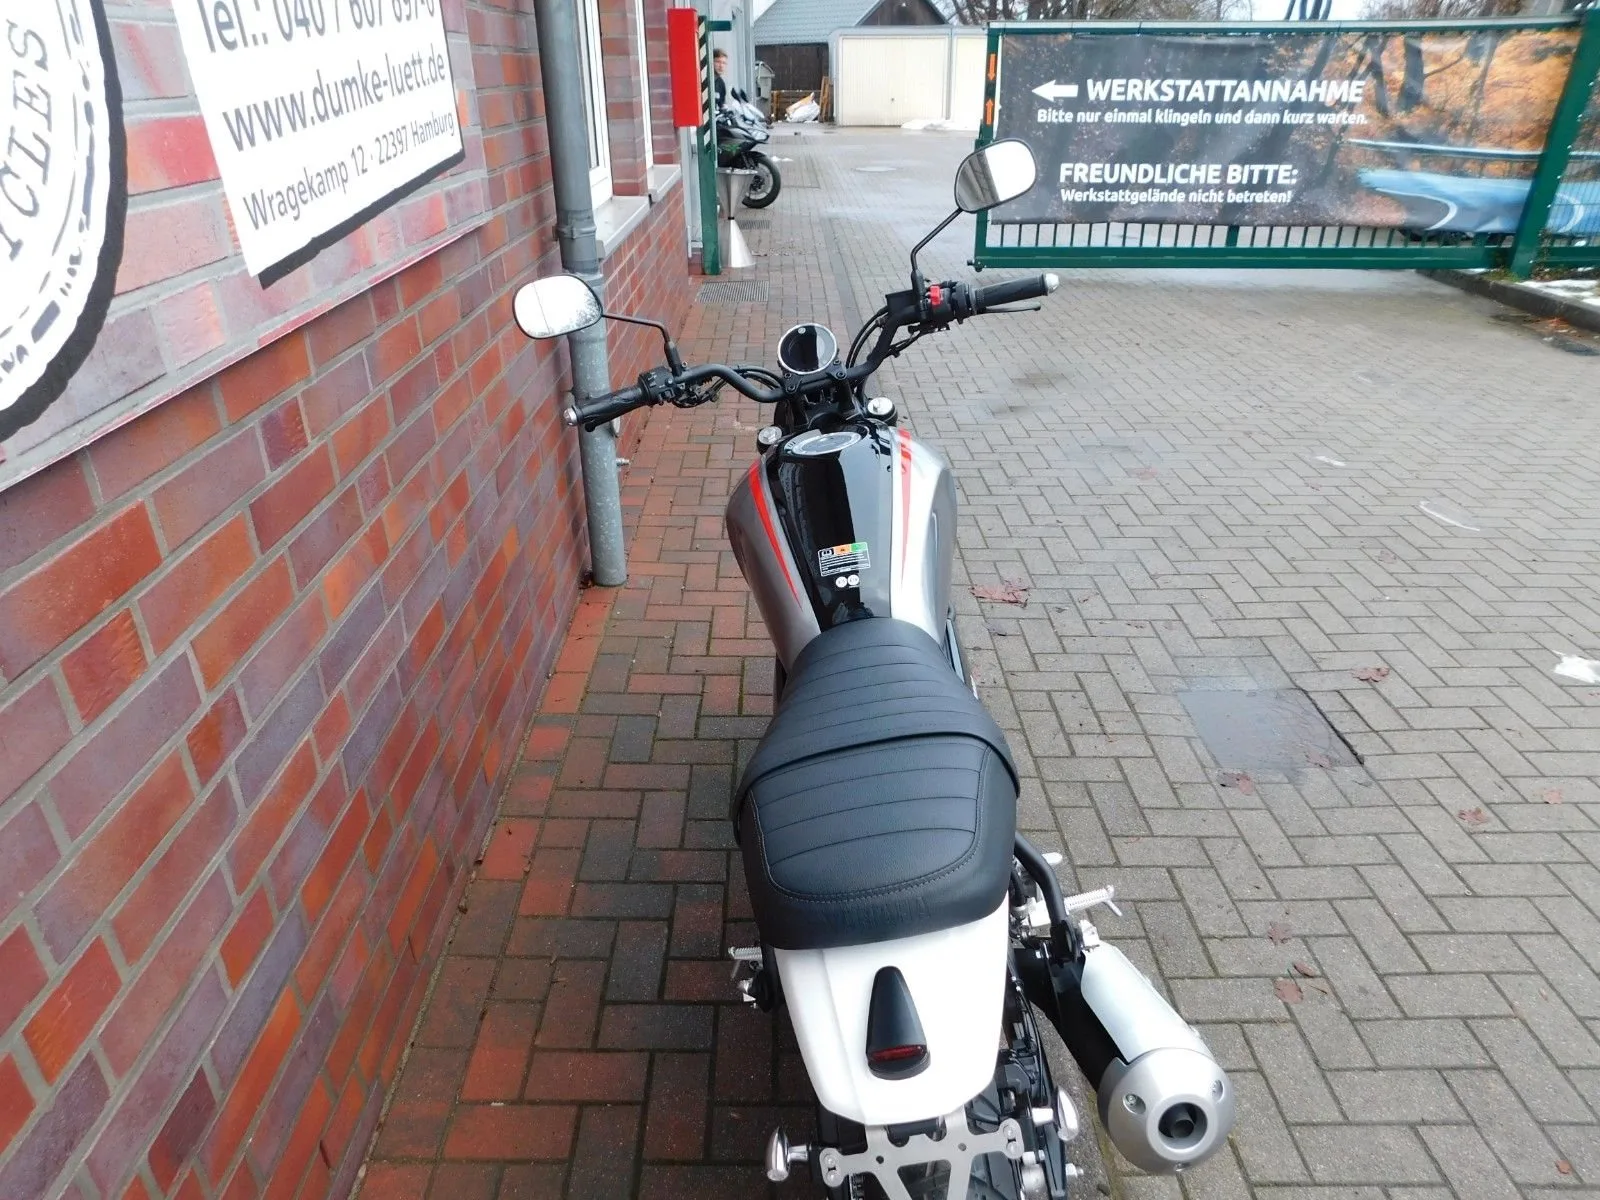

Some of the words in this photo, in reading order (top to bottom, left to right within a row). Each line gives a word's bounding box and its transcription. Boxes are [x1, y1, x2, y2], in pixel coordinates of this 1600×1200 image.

[221, 43, 446, 153] www.dumke-luett.de
[1086, 78, 1366, 103] WERKSTATTANNAHME
[1037, 108, 1074, 123] Bitte
[1076, 110, 1101, 123] nur
[1104, 108, 1152, 124] einmal
[1155, 108, 1211, 127] klingeln
[1214, 109, 1245, 124] und
[1244, 109, 1280, 124] dann
[1282, 109, 1314, 125] kurz
[1316, 110, 1368, 125] warten.
[242, 159, 350, 231] Wragekamp
[350, 144, 368, 177] 12
[374, 125, 410, 165] 22397
[410, 111, 455, 148] Hamburg
[1059, 162, 1221, 184] FREUNDLICHE
[1226, 163, 1299, 185] BITTE:
[1060, 188, 1186, 205] Werkstattgelände
[1189, 189, 1224, 204] nicht
[1227, 189, 1292, 204] betreten!
